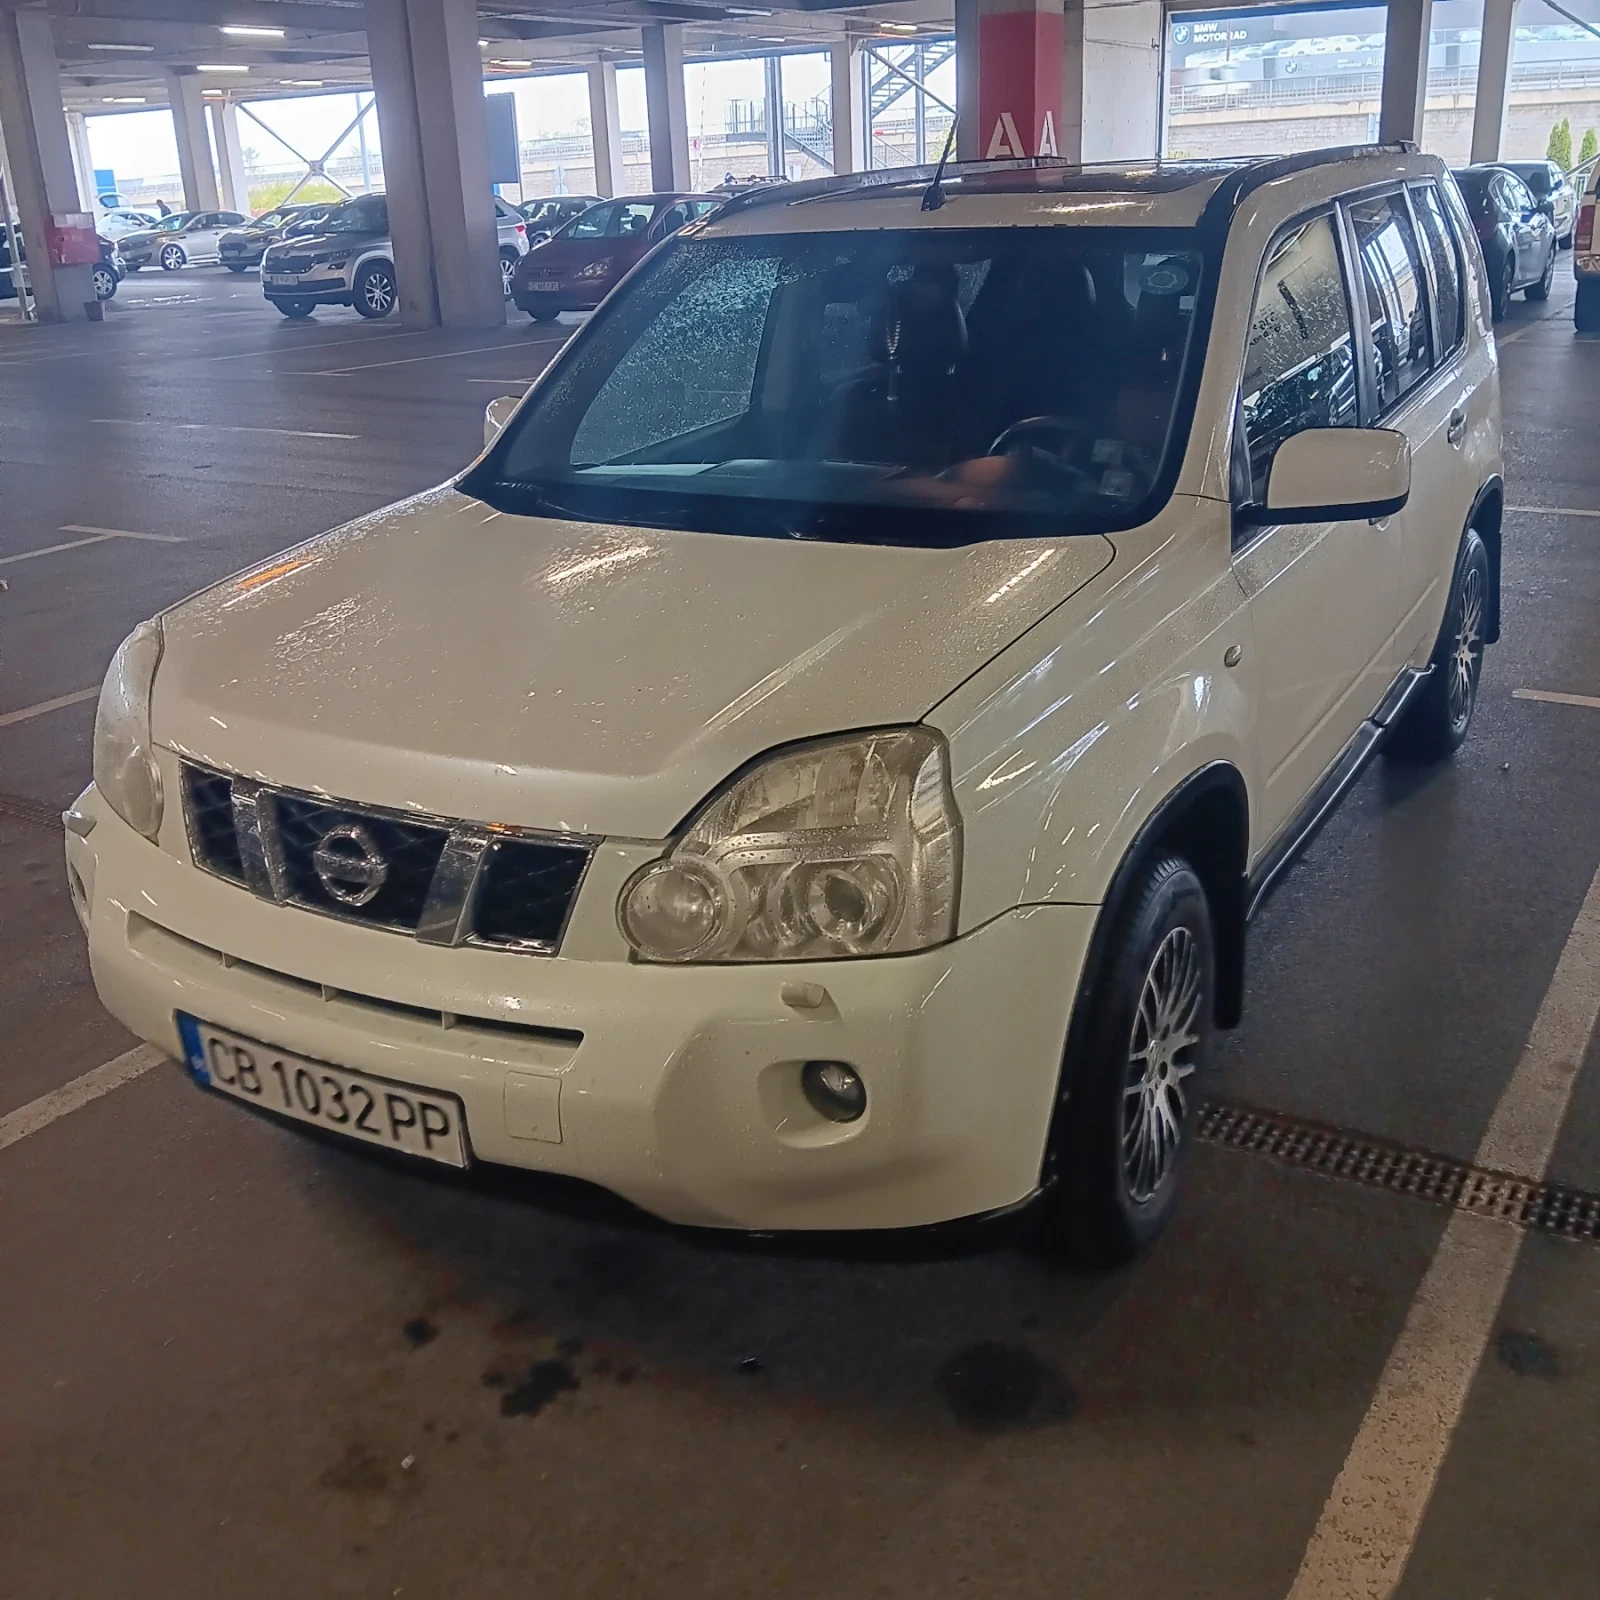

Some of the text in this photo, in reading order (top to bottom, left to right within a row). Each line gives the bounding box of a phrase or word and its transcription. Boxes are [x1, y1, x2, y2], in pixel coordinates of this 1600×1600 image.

[1193, 23, 1219, 33] BMW
[985, 112, 1026, 159] A
[1038, 110, 1059, 157] A
[270, 1060, 381, 1135] 1032
[383, 1092, 450, 1150] PP
